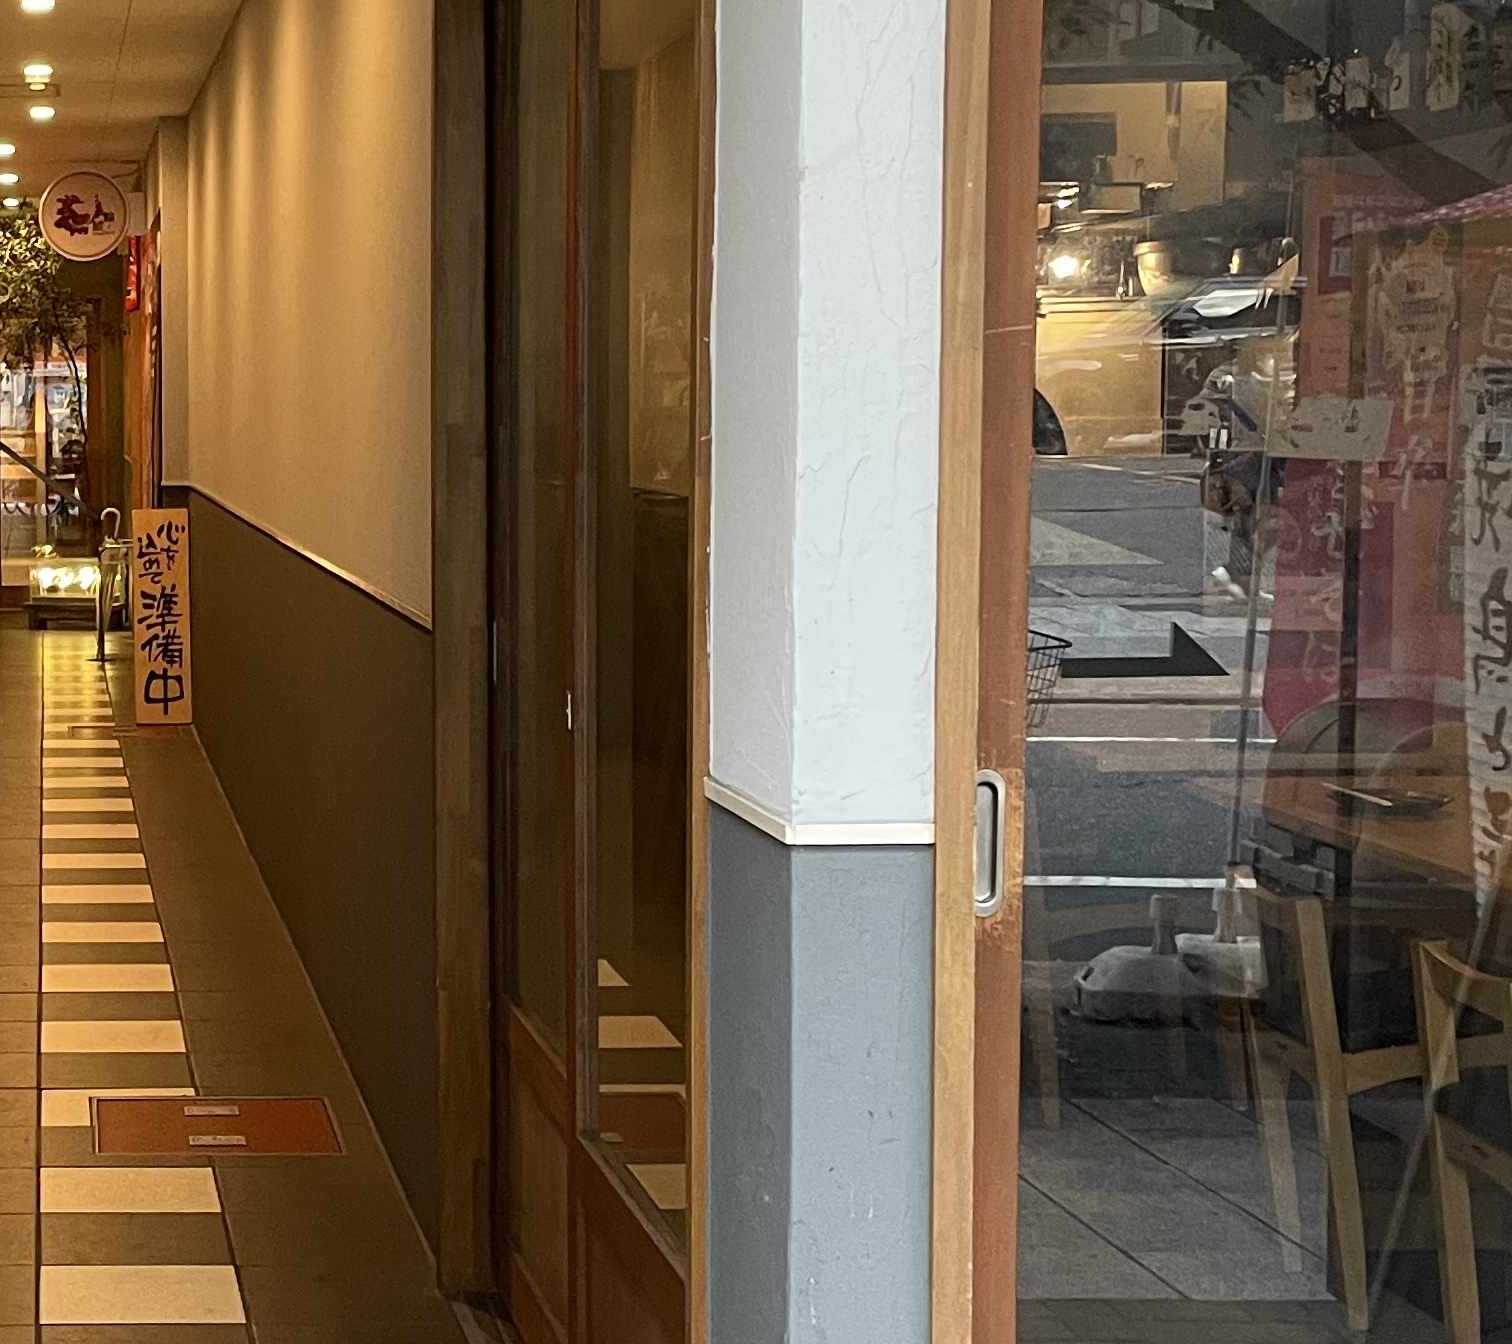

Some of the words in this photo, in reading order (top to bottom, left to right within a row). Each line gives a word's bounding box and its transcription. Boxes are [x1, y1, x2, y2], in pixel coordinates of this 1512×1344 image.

[157, 520, 185, 570] 心を
[137, 583, 185, 715] 準備中
